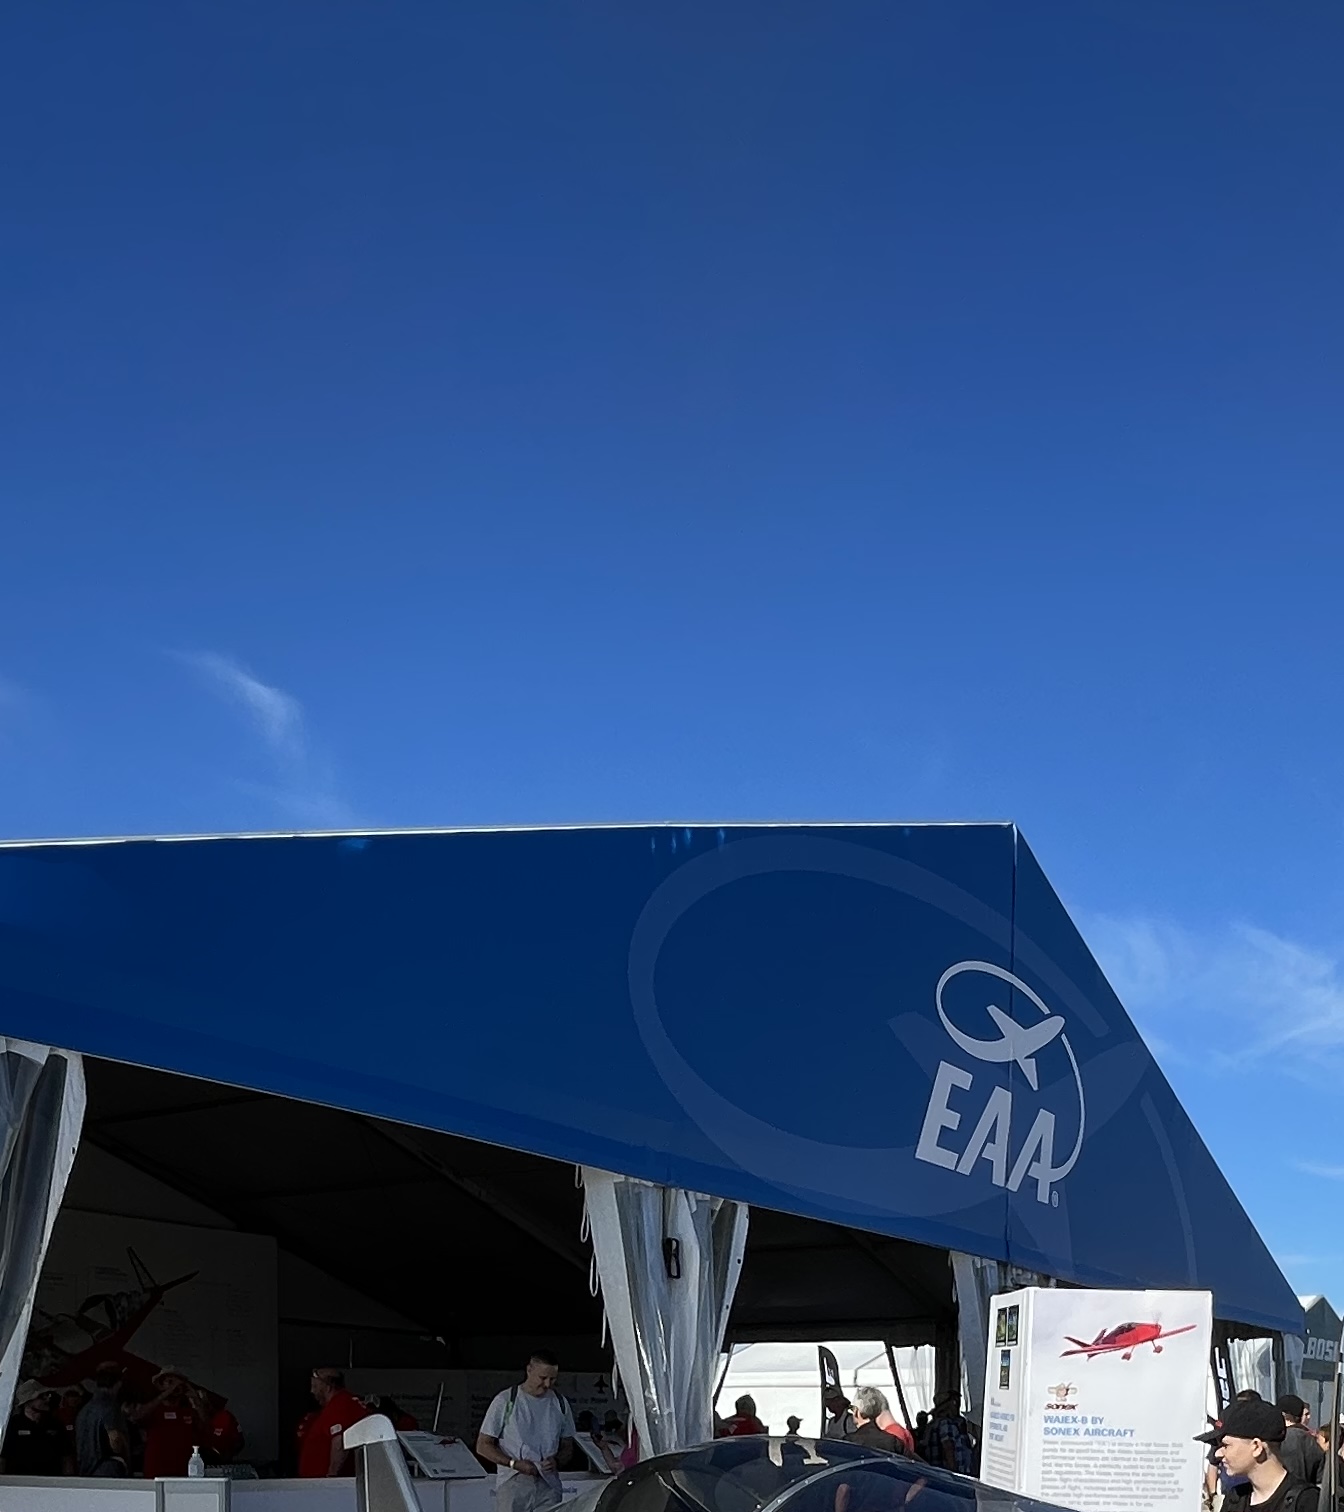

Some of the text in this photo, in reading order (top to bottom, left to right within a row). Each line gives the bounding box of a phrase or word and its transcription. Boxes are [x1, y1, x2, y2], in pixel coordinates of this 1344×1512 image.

[915, 1060, 1056, 1205] EAA
[1091, 1415, 1105, 1425] BY
[1043, 1426, 1136, 1438] SONEX AIRCRAFT
